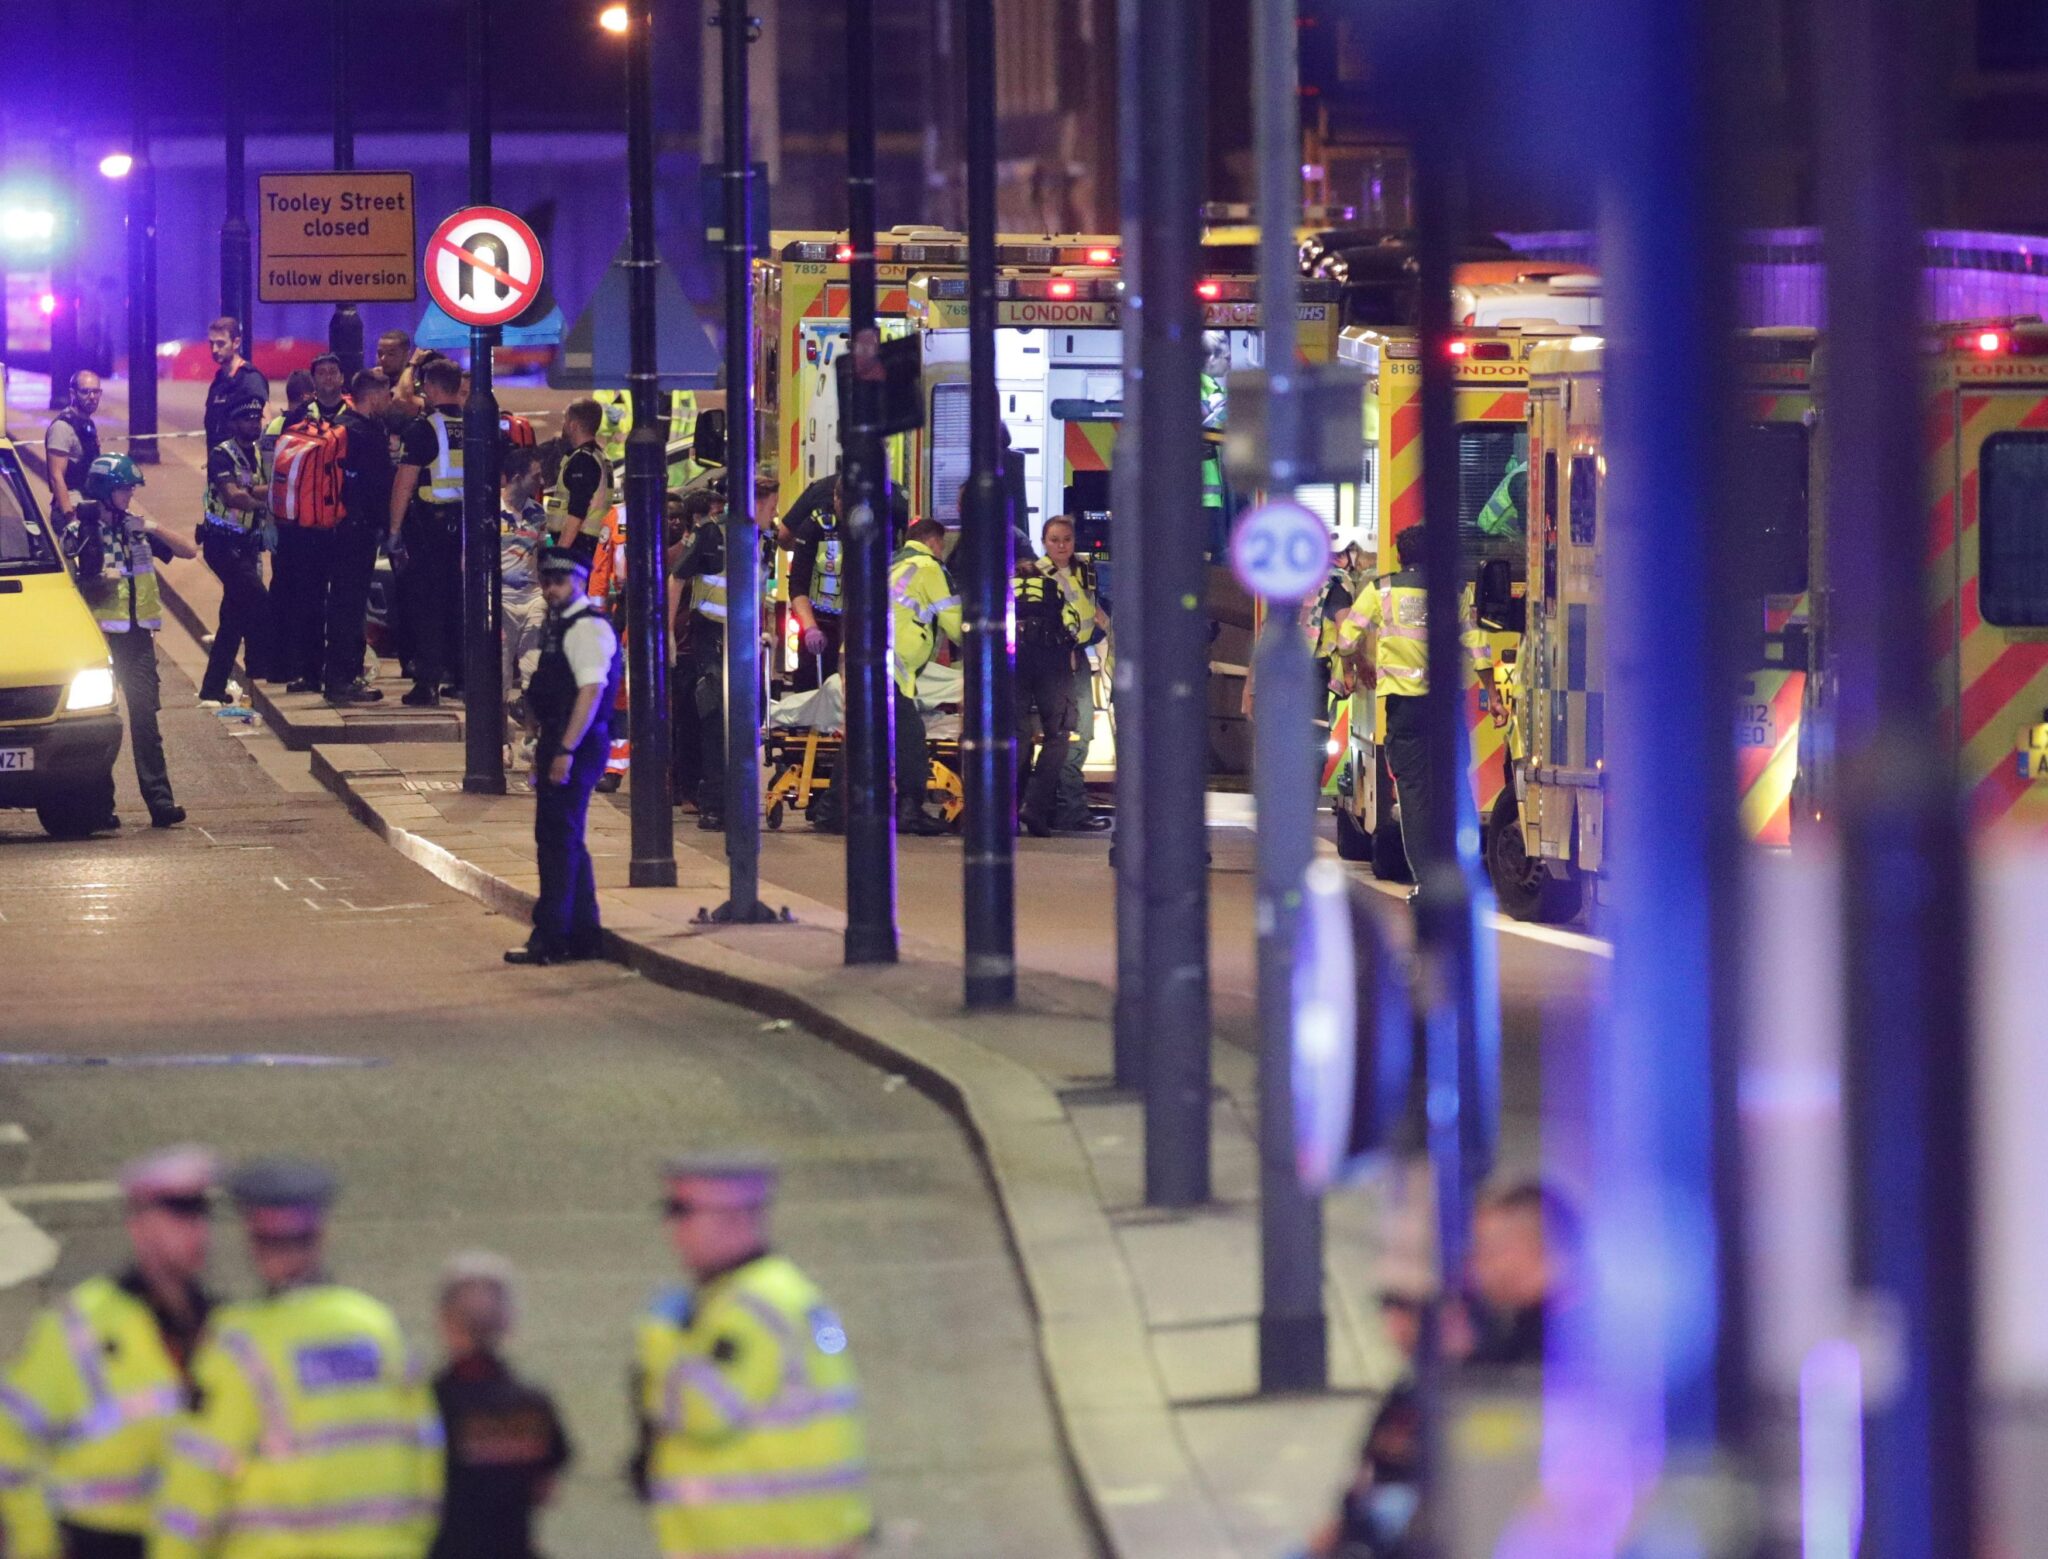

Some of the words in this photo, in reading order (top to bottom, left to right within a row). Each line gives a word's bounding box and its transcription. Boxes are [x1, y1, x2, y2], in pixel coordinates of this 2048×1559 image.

[267, 192, 332, 214] Tooley
[340, 191, 406, 211] Street
[303, 217, 370, 236] closed
[268, 270, 322, 286] follow
[328, 269, 407, 286] diversion
[793, 264, 827, 274] 7892
[1010, 304, 1093, 321] LONDON
[1247, 530, 1320, 572] 20
